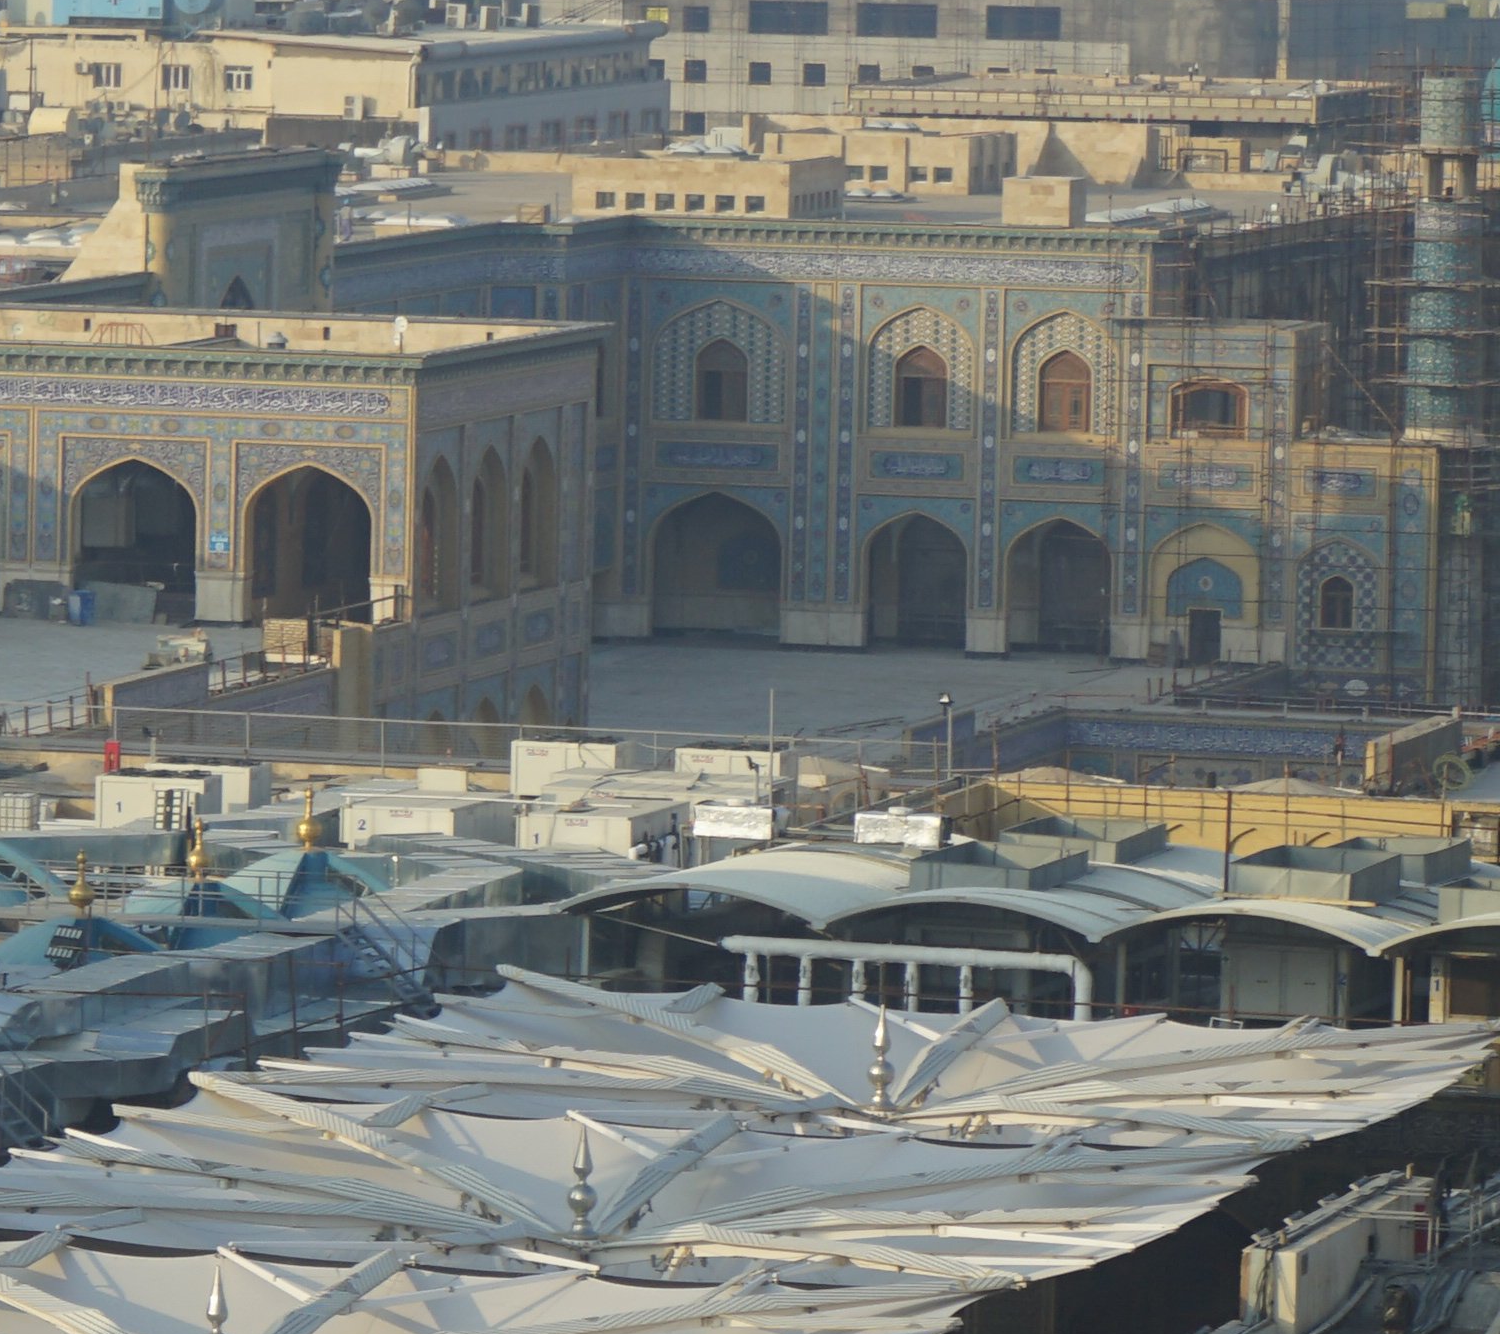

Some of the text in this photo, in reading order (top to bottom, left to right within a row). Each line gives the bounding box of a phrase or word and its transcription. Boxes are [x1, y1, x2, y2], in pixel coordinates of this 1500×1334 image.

[115, 800, 122, 813] 1
[357, 818, 367, 831] 2
[533, 833, 540, 845] 1
[1434, 978, 1440, 992] 1
